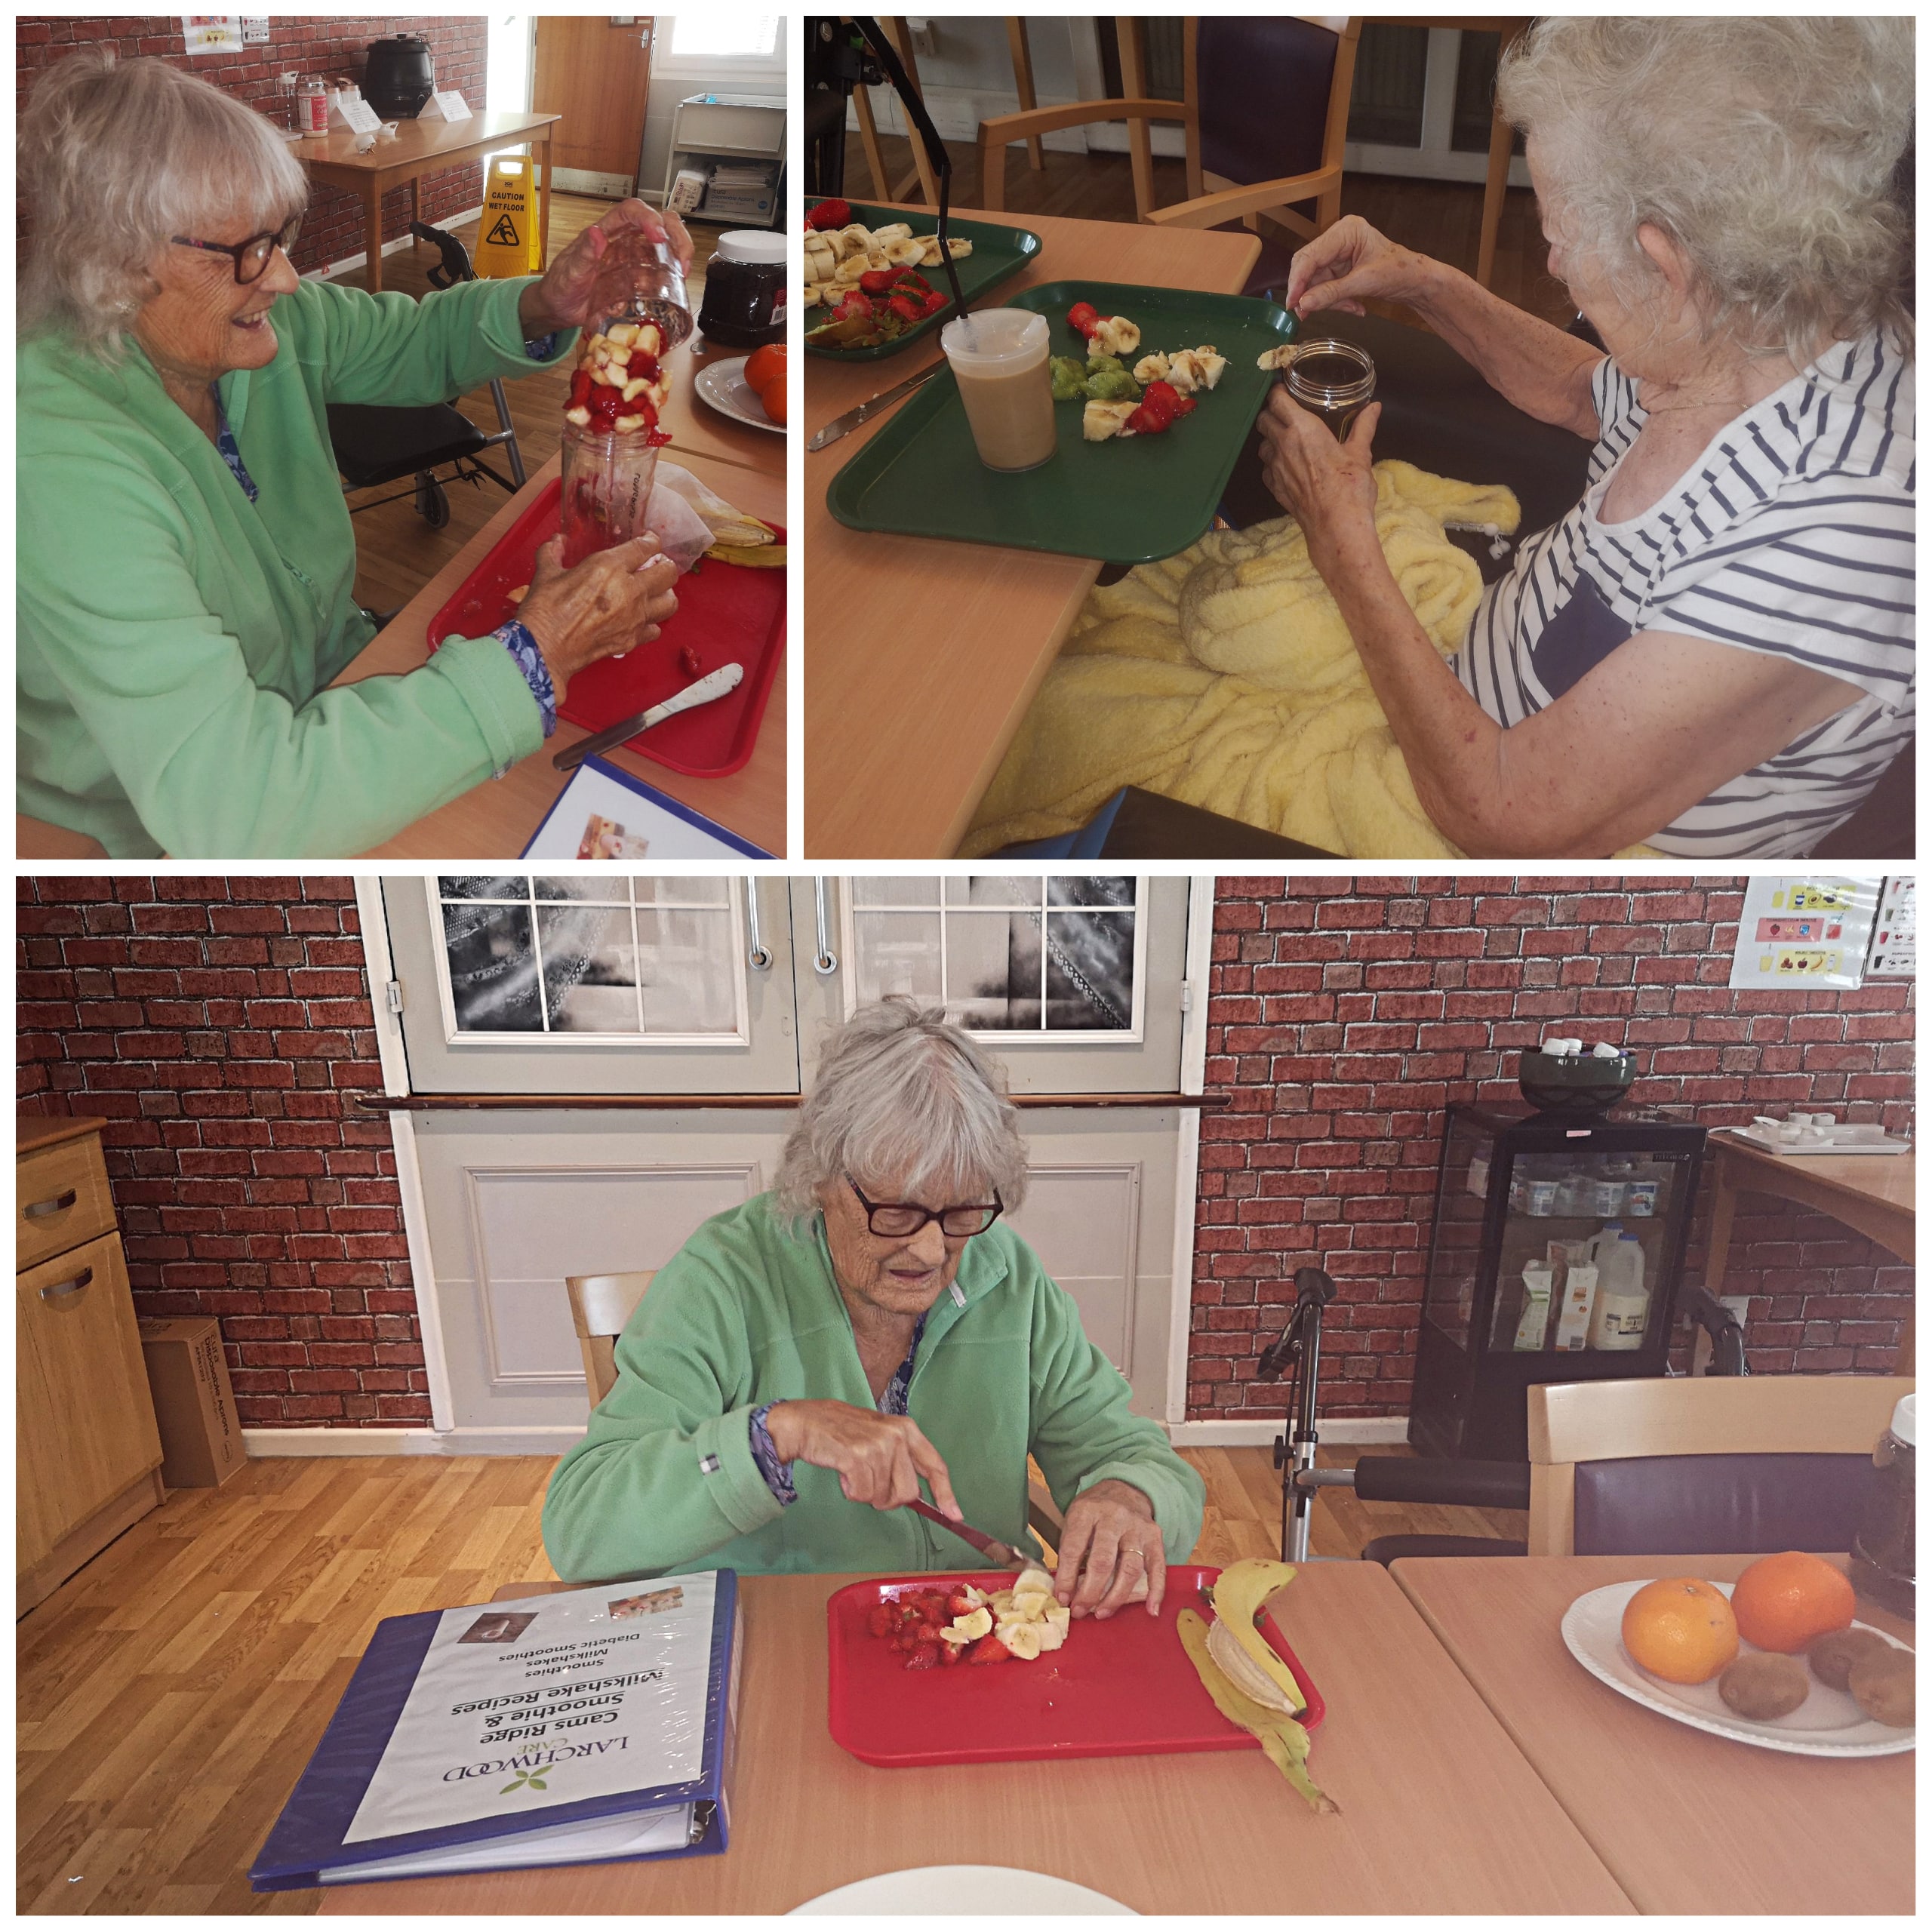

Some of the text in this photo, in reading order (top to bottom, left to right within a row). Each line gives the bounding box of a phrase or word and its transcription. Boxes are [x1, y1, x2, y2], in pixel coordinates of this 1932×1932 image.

[488, 202, 525, 212] WET FLOOR
[491, 192, 525, 201] CAUTION
[205, 1337, 220, 1396] Disposable
[218, 1399, 229, 1436] Aprons
[499, 1633, 640, 1662] Diabetic Smoothies
[526, 1648, 608, 1666] Milkshakes
[525, 1659, 605, 1678] Smoothies
[451, 1671, 663, 1715] Milkshake Recipes
[485, 1694, 624, 1727] Smoothie &
[479, 1711, 618, 1744] Cams Ridge
[443, 1736, 629, 1782] LARCHWOOD
[517, 1737, 568, 1755] CARE
